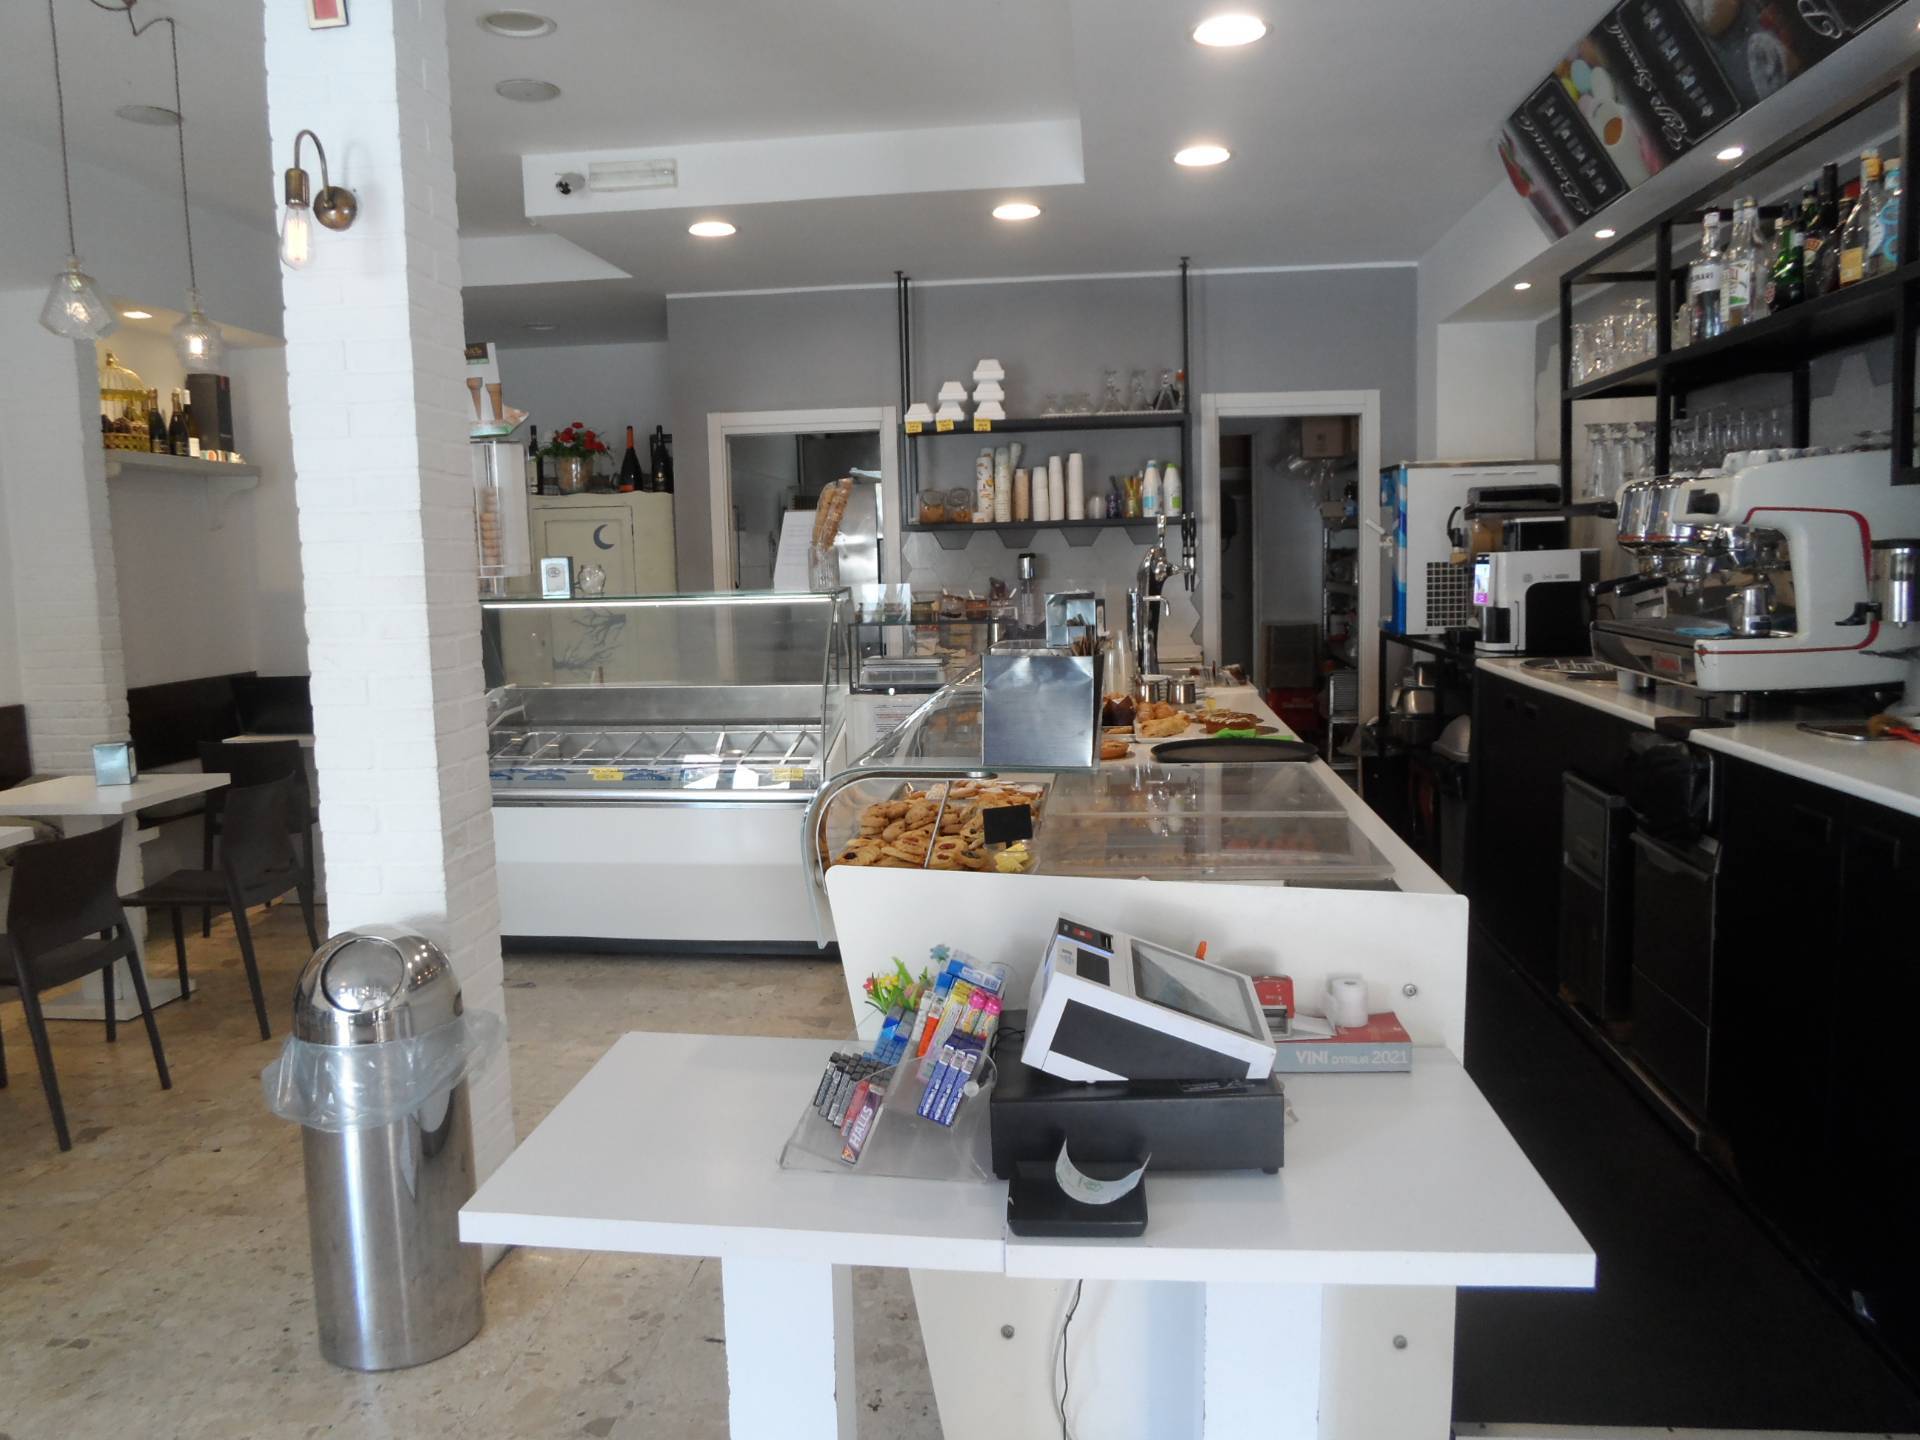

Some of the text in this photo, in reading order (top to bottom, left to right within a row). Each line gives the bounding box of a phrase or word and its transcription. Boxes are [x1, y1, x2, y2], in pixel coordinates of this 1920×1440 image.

[1295, 1051, 1329, 1065] VINI
[1371, 1050, 1409, 1065] 2021
[848, 1105, 873, 1148] HALLS
